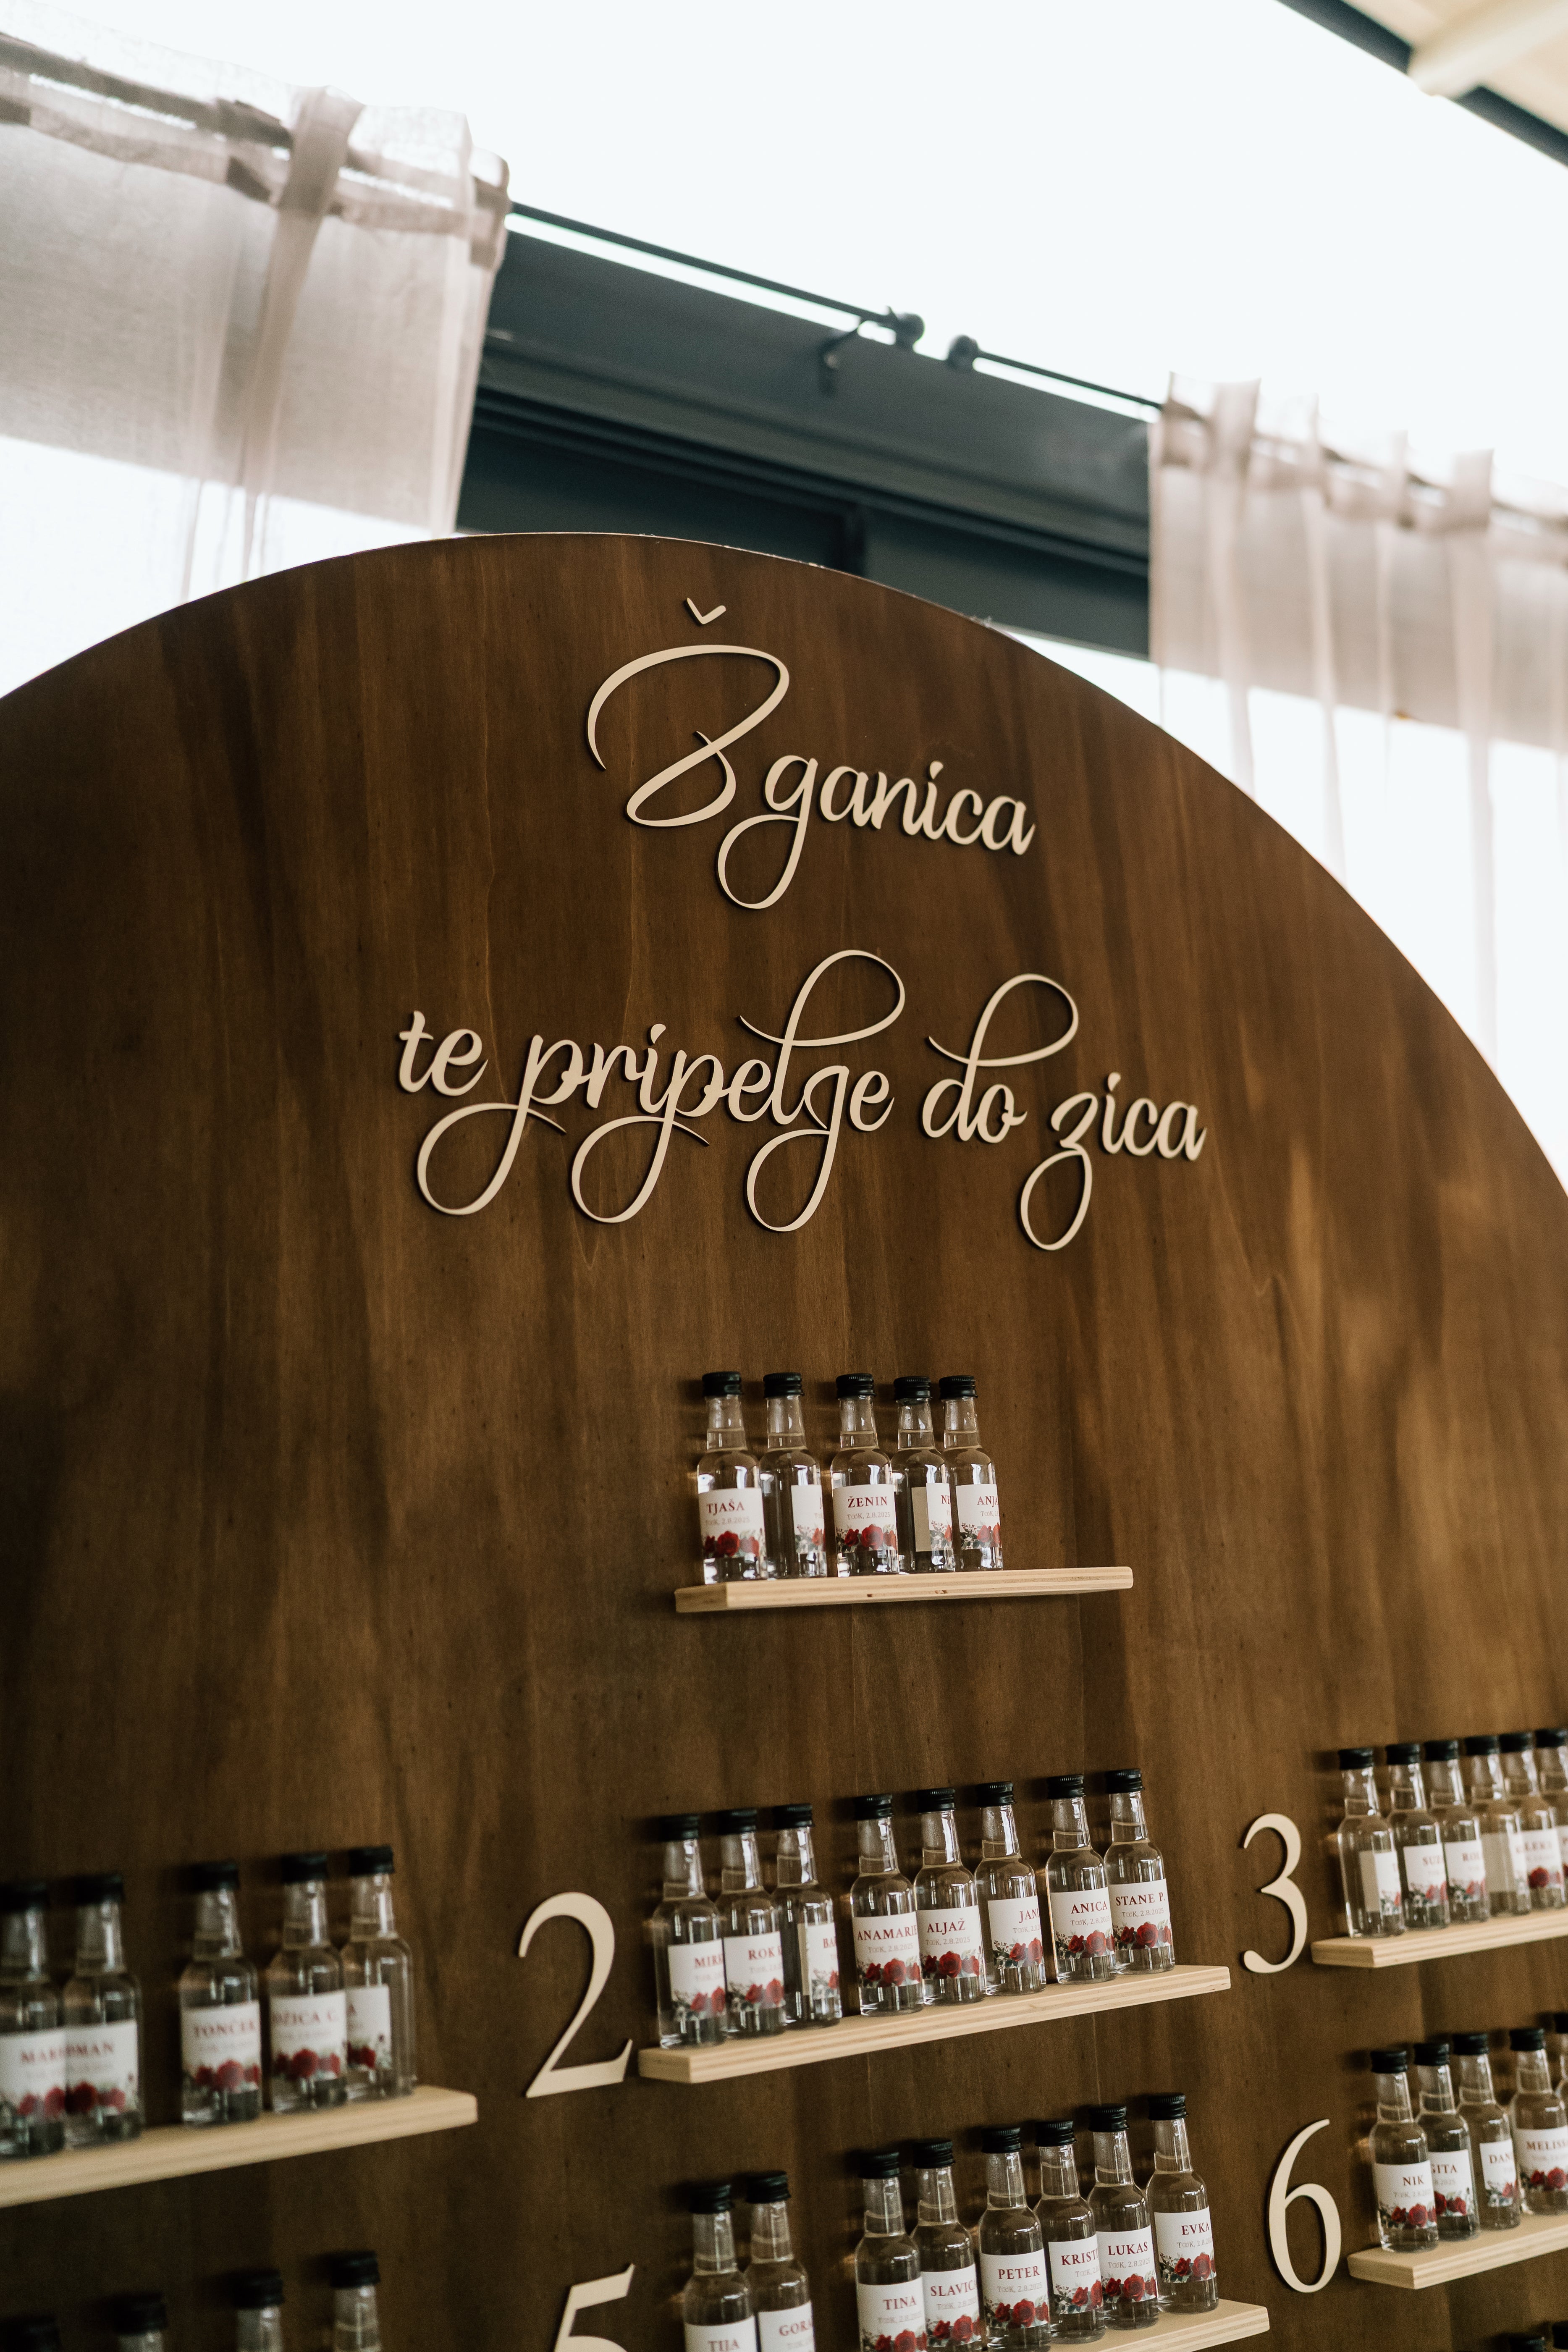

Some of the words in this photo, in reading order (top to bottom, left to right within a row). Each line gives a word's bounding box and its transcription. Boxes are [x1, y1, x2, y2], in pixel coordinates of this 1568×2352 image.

[588, 598, 1036, 909] Žganica
[399, 1010, 488, 1097] te
[922, 973, 1079, 1143] do
[706, 1498, 745, 1516] TJAŠA
[847, 1495, 887, 1508] ŽENIN
[1115, 1893, 1155, 1906] STANE
[1159, 1892, 1165, 1901] P.
[1243, 1813, 1308, 1974] 3
[1070, 1901, 1108, 1914] ANICA
[1141, 1908, 1164, 1916] 2.8.2025
[926, 1918, 966, 1935] ALJAŽ
[943, 1936, 970, 1945] 2.8.2025
[747, 1947, 775, 1961] ROK
[518, 1891, 633, 2098] 2
[1403, 2175, 1424, 2186] NIK
[1269, 2119, 1341, 2293] 6
[1181, 2221, 1210, 2236] EVKA
[1107, 2241, 1148, 2256] LUKAS
[1127, 2257, 1151, 2268] 2.8.2025
[997, 2265, 1040, 2280] PETER
[930, 2280, 977, 2297] SLAVIC
[883, 2295, 917, 2310] TINA
